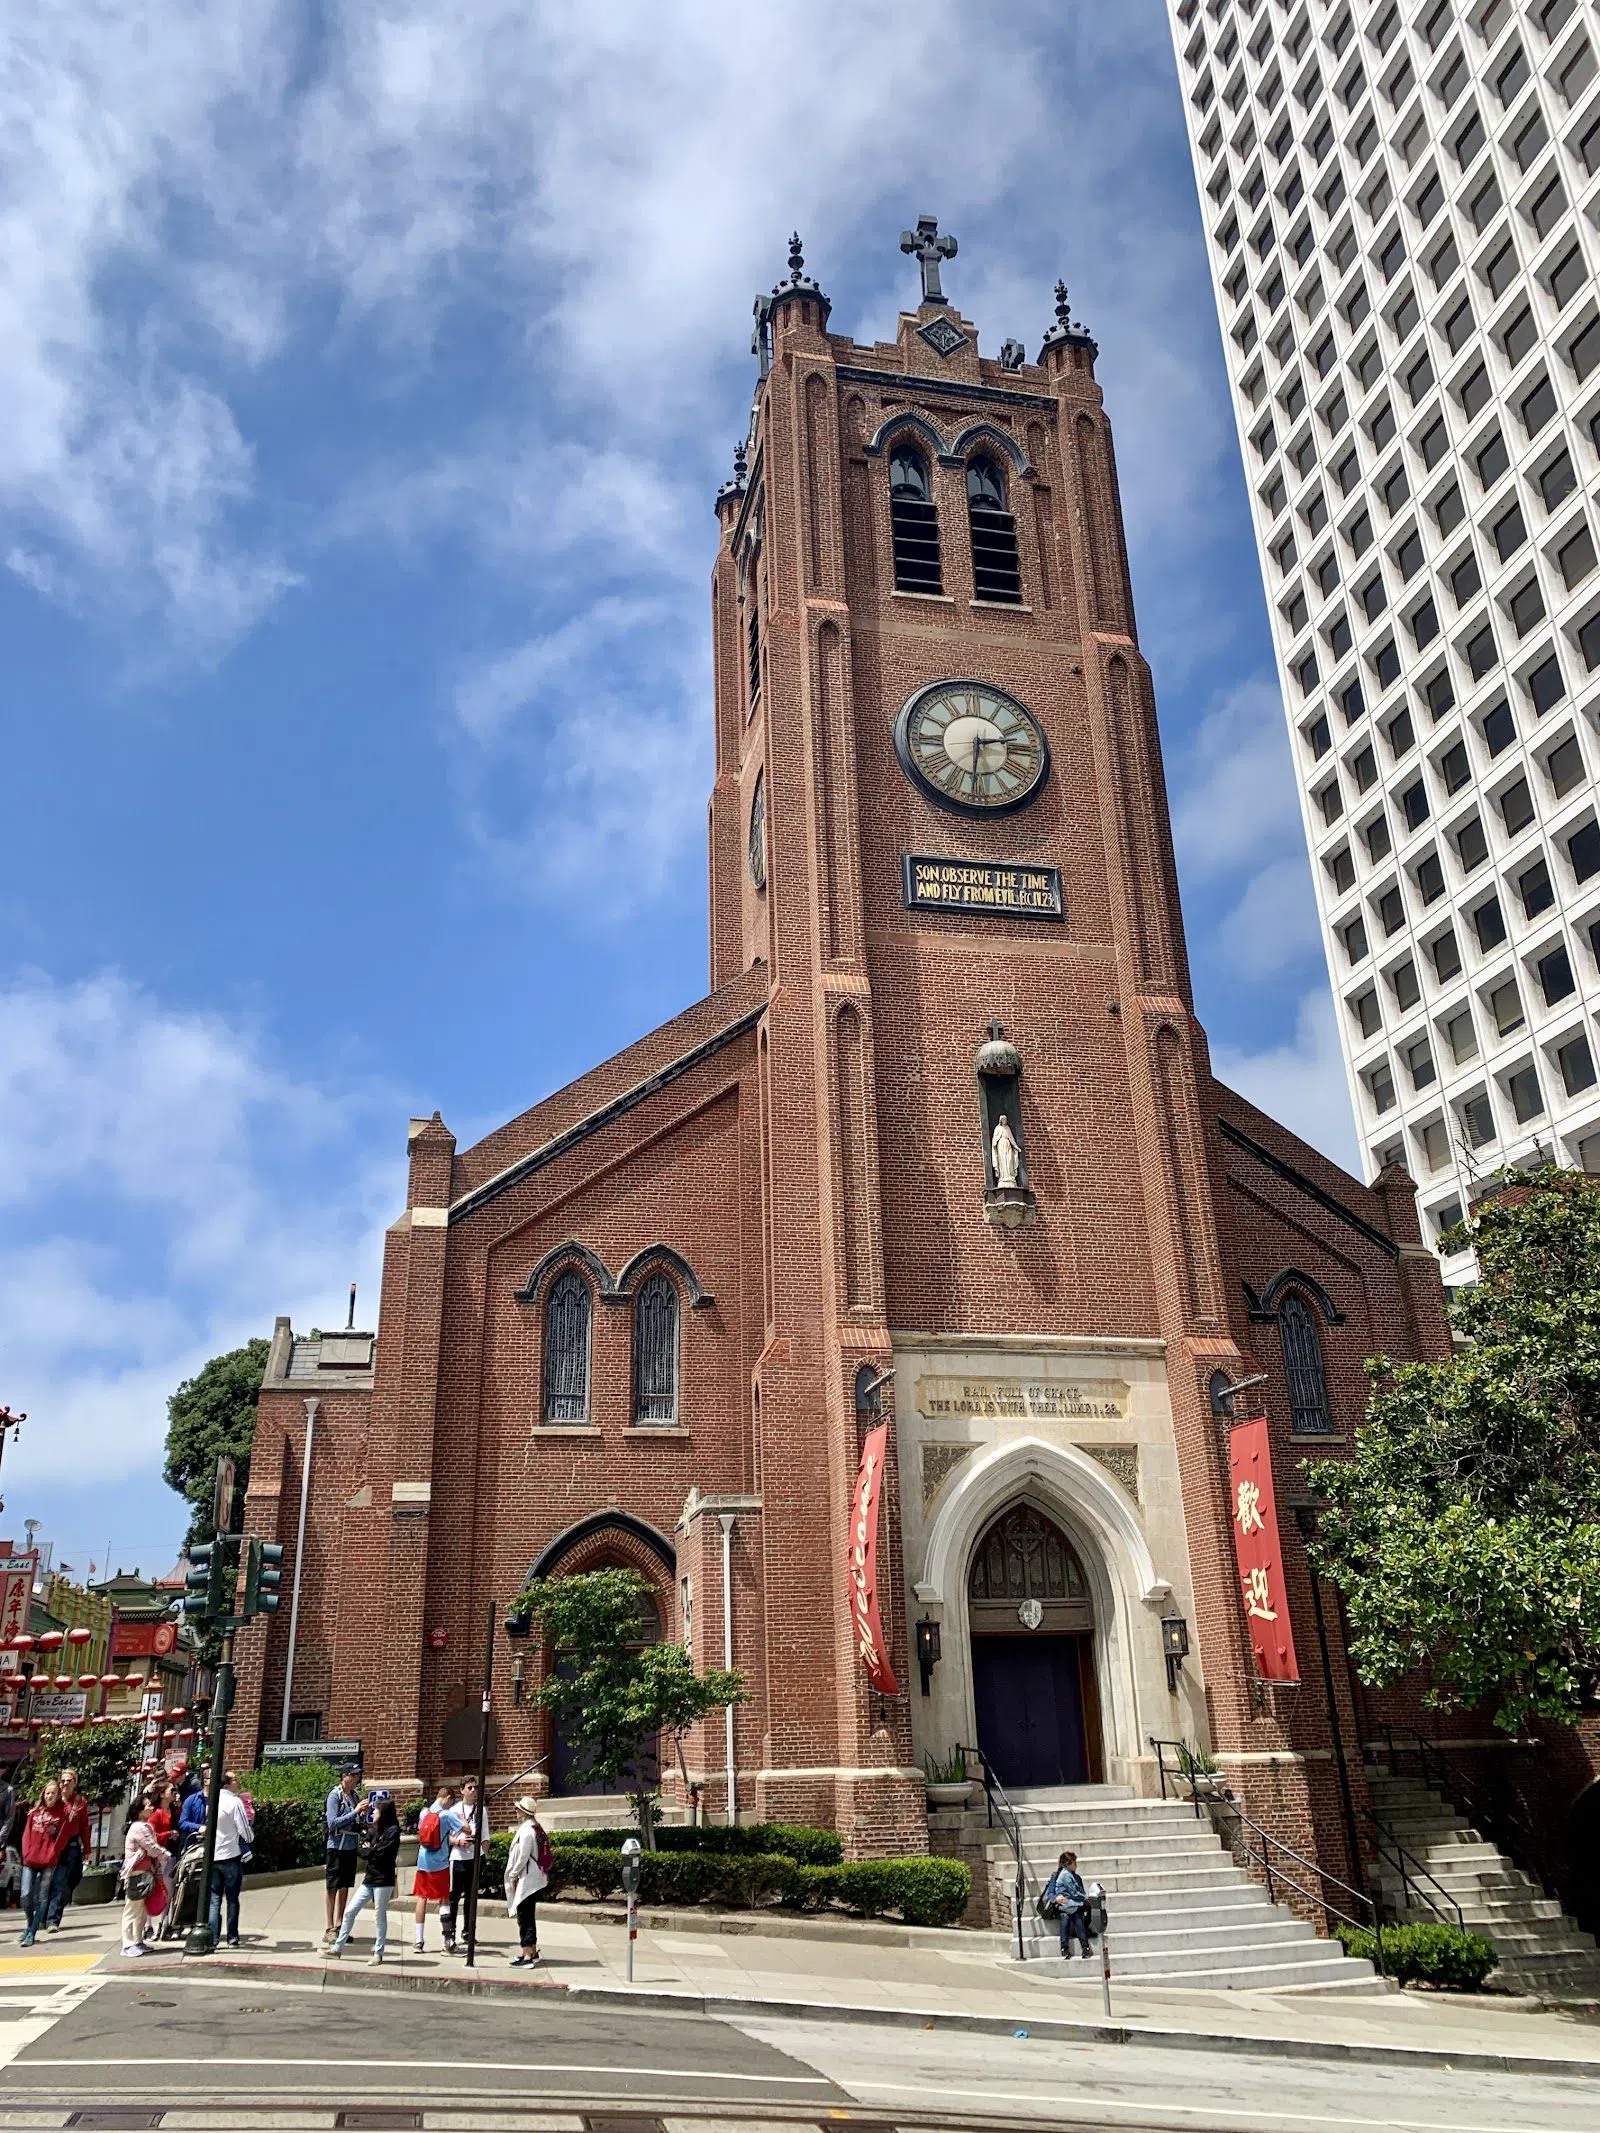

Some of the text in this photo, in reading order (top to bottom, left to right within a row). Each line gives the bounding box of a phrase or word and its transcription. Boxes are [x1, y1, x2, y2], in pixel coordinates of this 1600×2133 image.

[942, 867, 993, 886] OBSERVE
[994, 871, 1018, 888] THE
[1020, 874, 1050, 890] TIME
[918, 882, 940, 899] AND
[943, 884, 963, 900] FLY
[963, 885, 994, 903] FROM
[1028, 1387, 1040, 1398] OF
[929, 1400, 950, 1411] THE
[954, 1400, 981, 1412] LORD
[983, 1401, 995, 1412] IS
[997, 1401, 1025, 1412] WITH
[1236, 1480, 1278, 1622] 歡迎
[7, 1560, 30, 1569] East
[852, 1452, 879, 1669] Welcome
[52, 1696, 74, 1706] East
